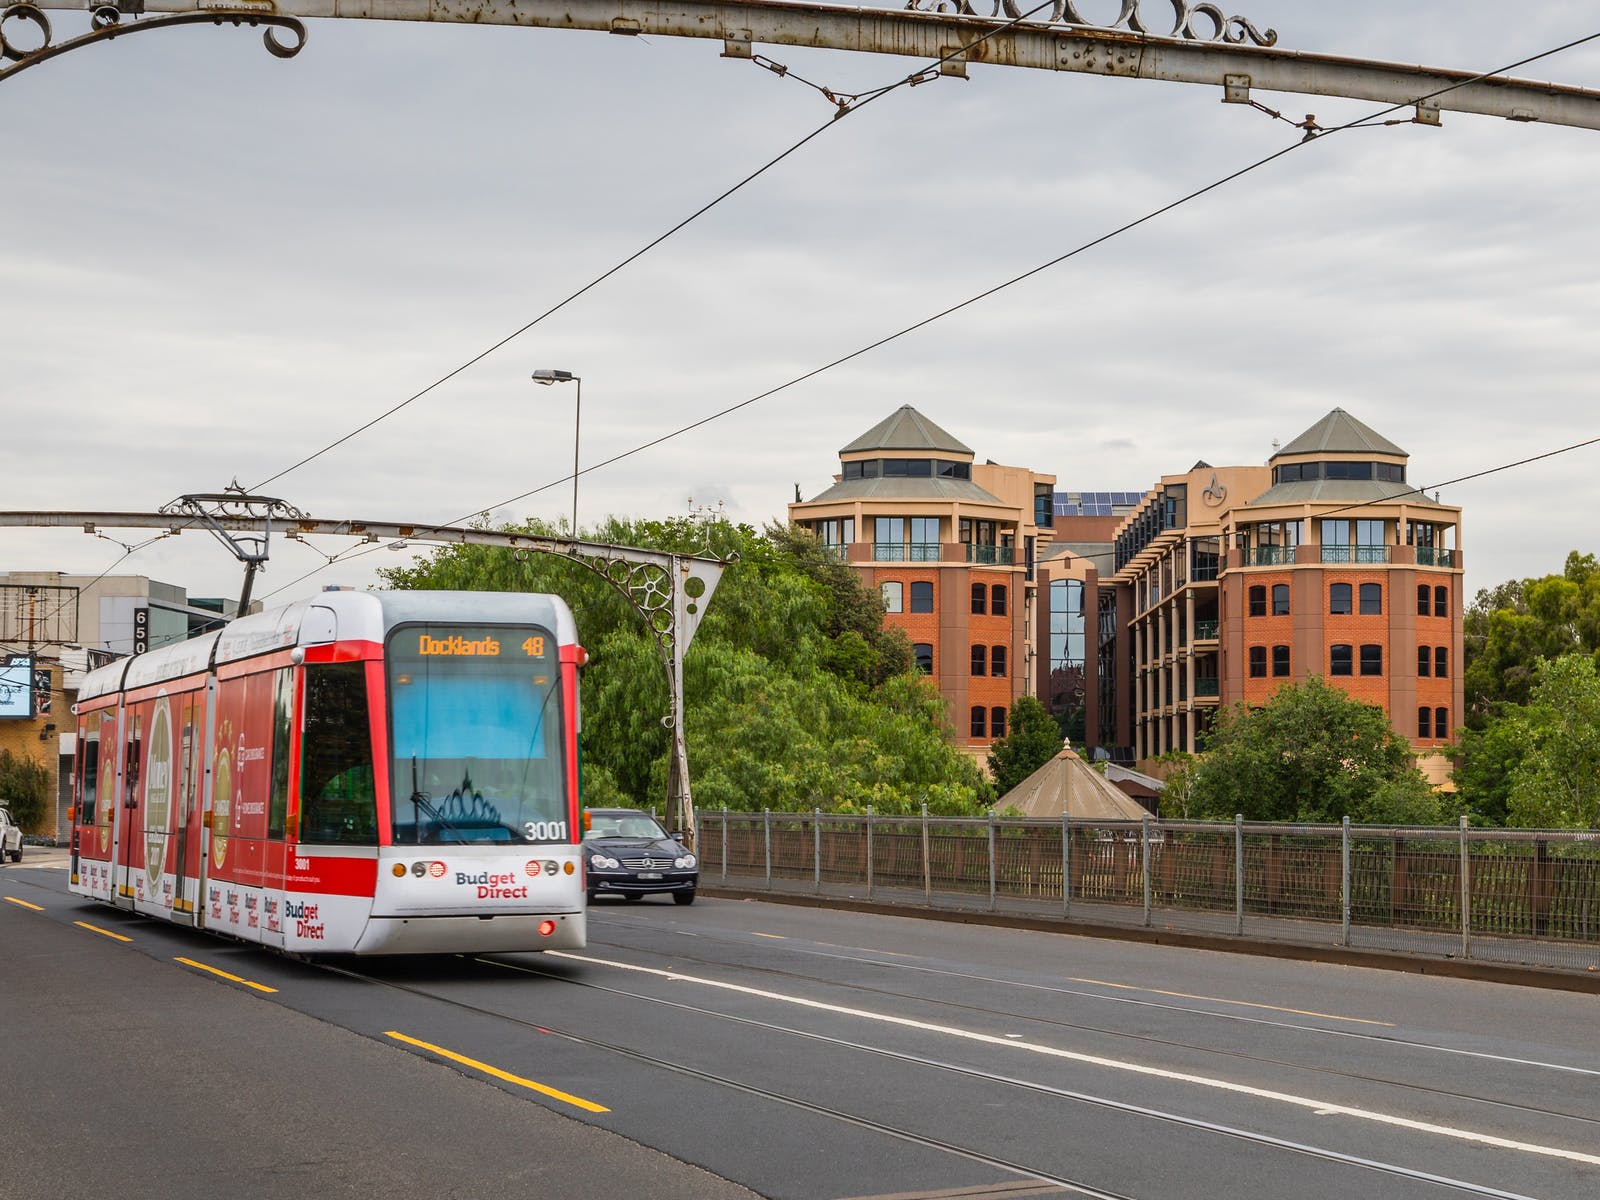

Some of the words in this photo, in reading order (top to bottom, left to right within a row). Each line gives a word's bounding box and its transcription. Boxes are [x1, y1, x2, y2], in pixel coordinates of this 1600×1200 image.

[136, 611, 146, 654] 650
[419, 635, 500, 656] Docklands
[524, 821, 567, 840] 3001
[294, 858, 310, 870] 3001
[456, 872, 516, 887] Budget
[477, 886, 528, 899] Direct
[285, 900, 319, 923] Budget
[296, 920, 325, 939] Direct
